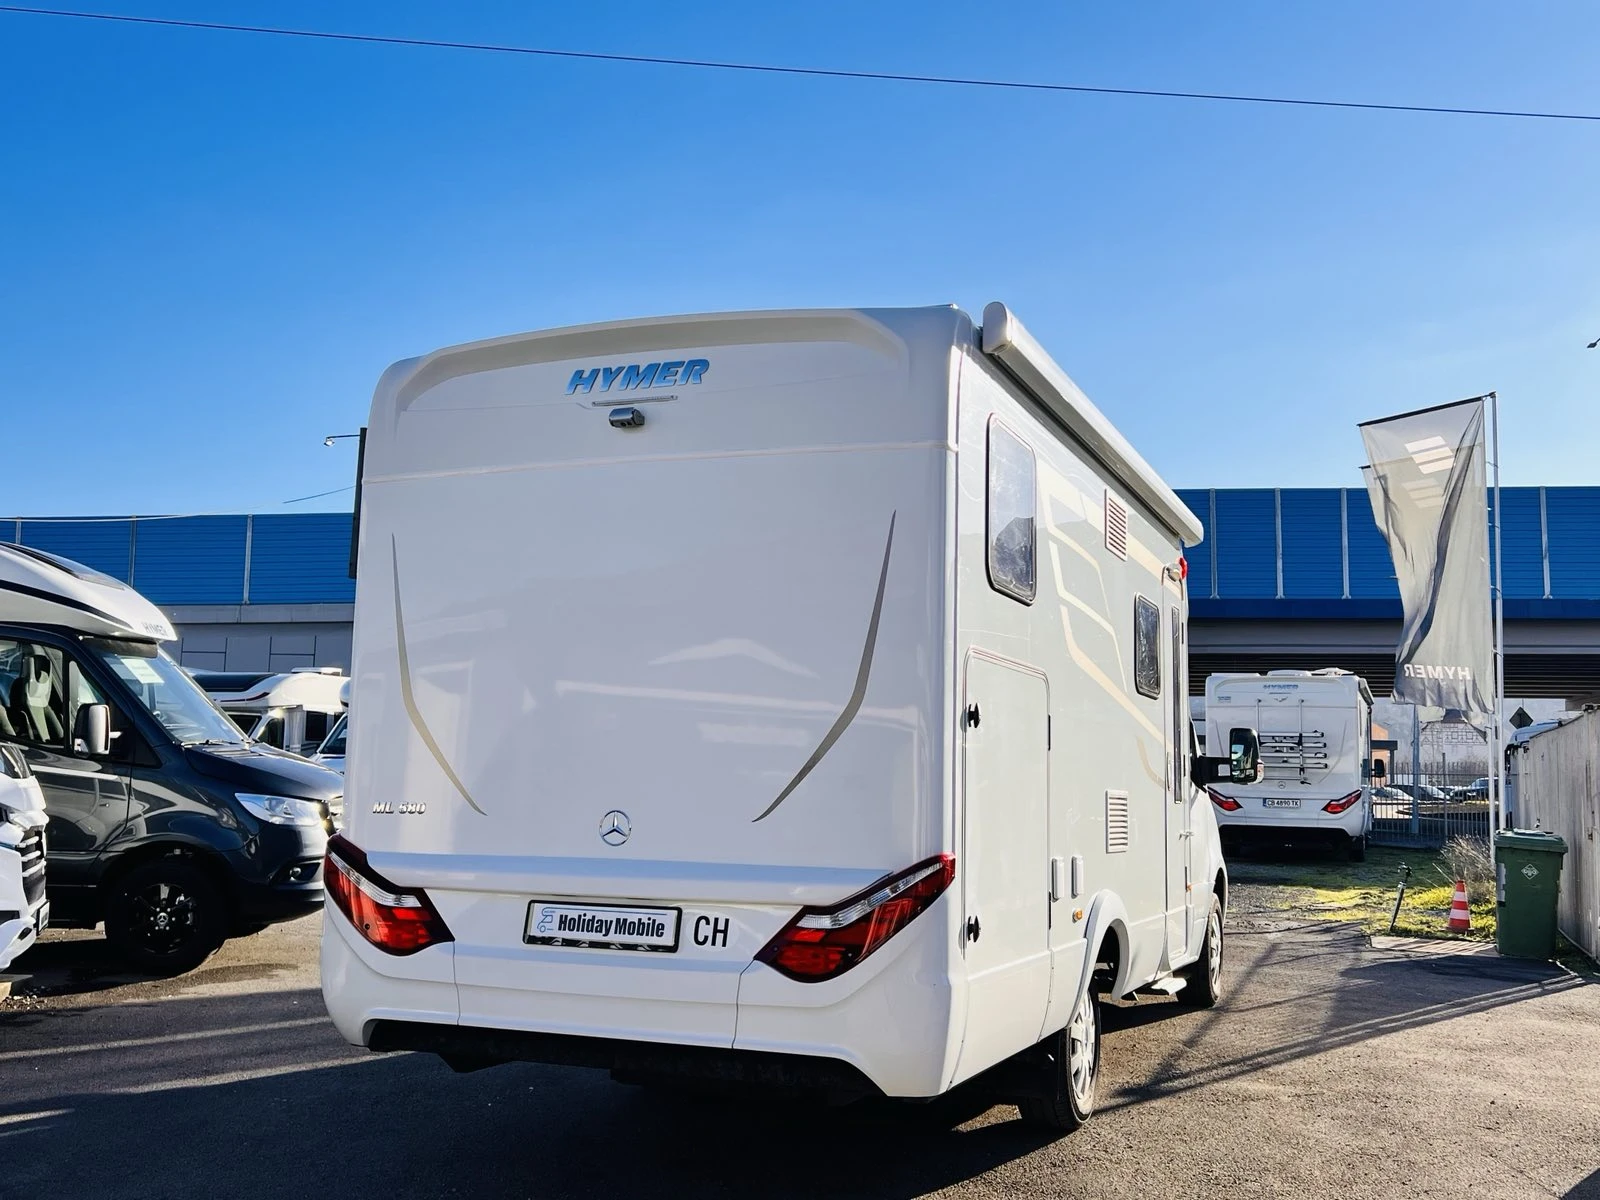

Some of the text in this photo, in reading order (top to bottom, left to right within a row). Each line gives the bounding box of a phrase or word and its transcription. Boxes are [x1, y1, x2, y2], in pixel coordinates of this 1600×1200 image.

[564, 358, 710, 395] HYMER
[373, 801, 394, 814] ML
[558, 913, 665, 938] Holiday Mobile
[693, 915, 730, 948] CH
